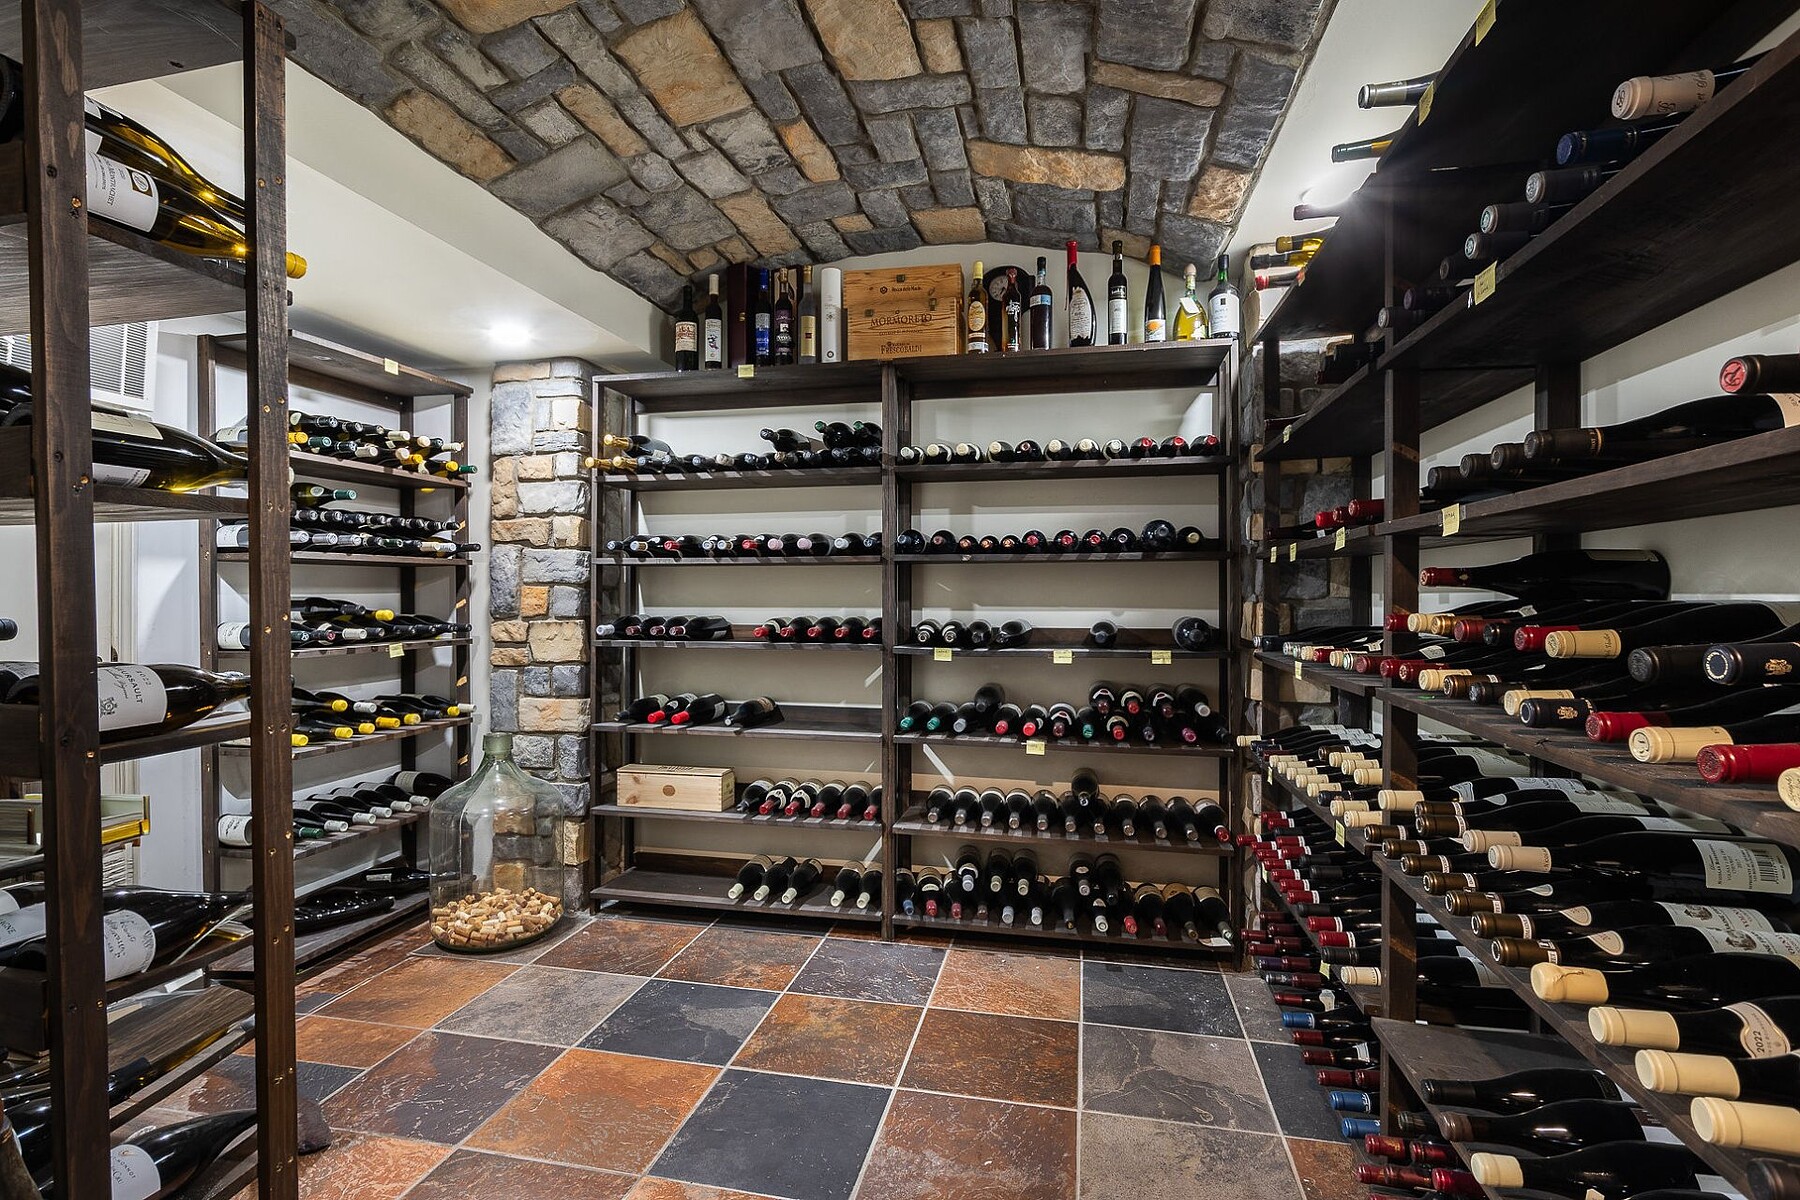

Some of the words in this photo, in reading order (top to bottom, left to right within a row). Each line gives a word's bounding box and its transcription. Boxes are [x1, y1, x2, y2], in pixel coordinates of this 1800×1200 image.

[870, 313, 933, 327] MORMORETO
[880, 345, 922, 354] FRESCOBALDI
[1752, 1030, 1765, 1053] 2022
